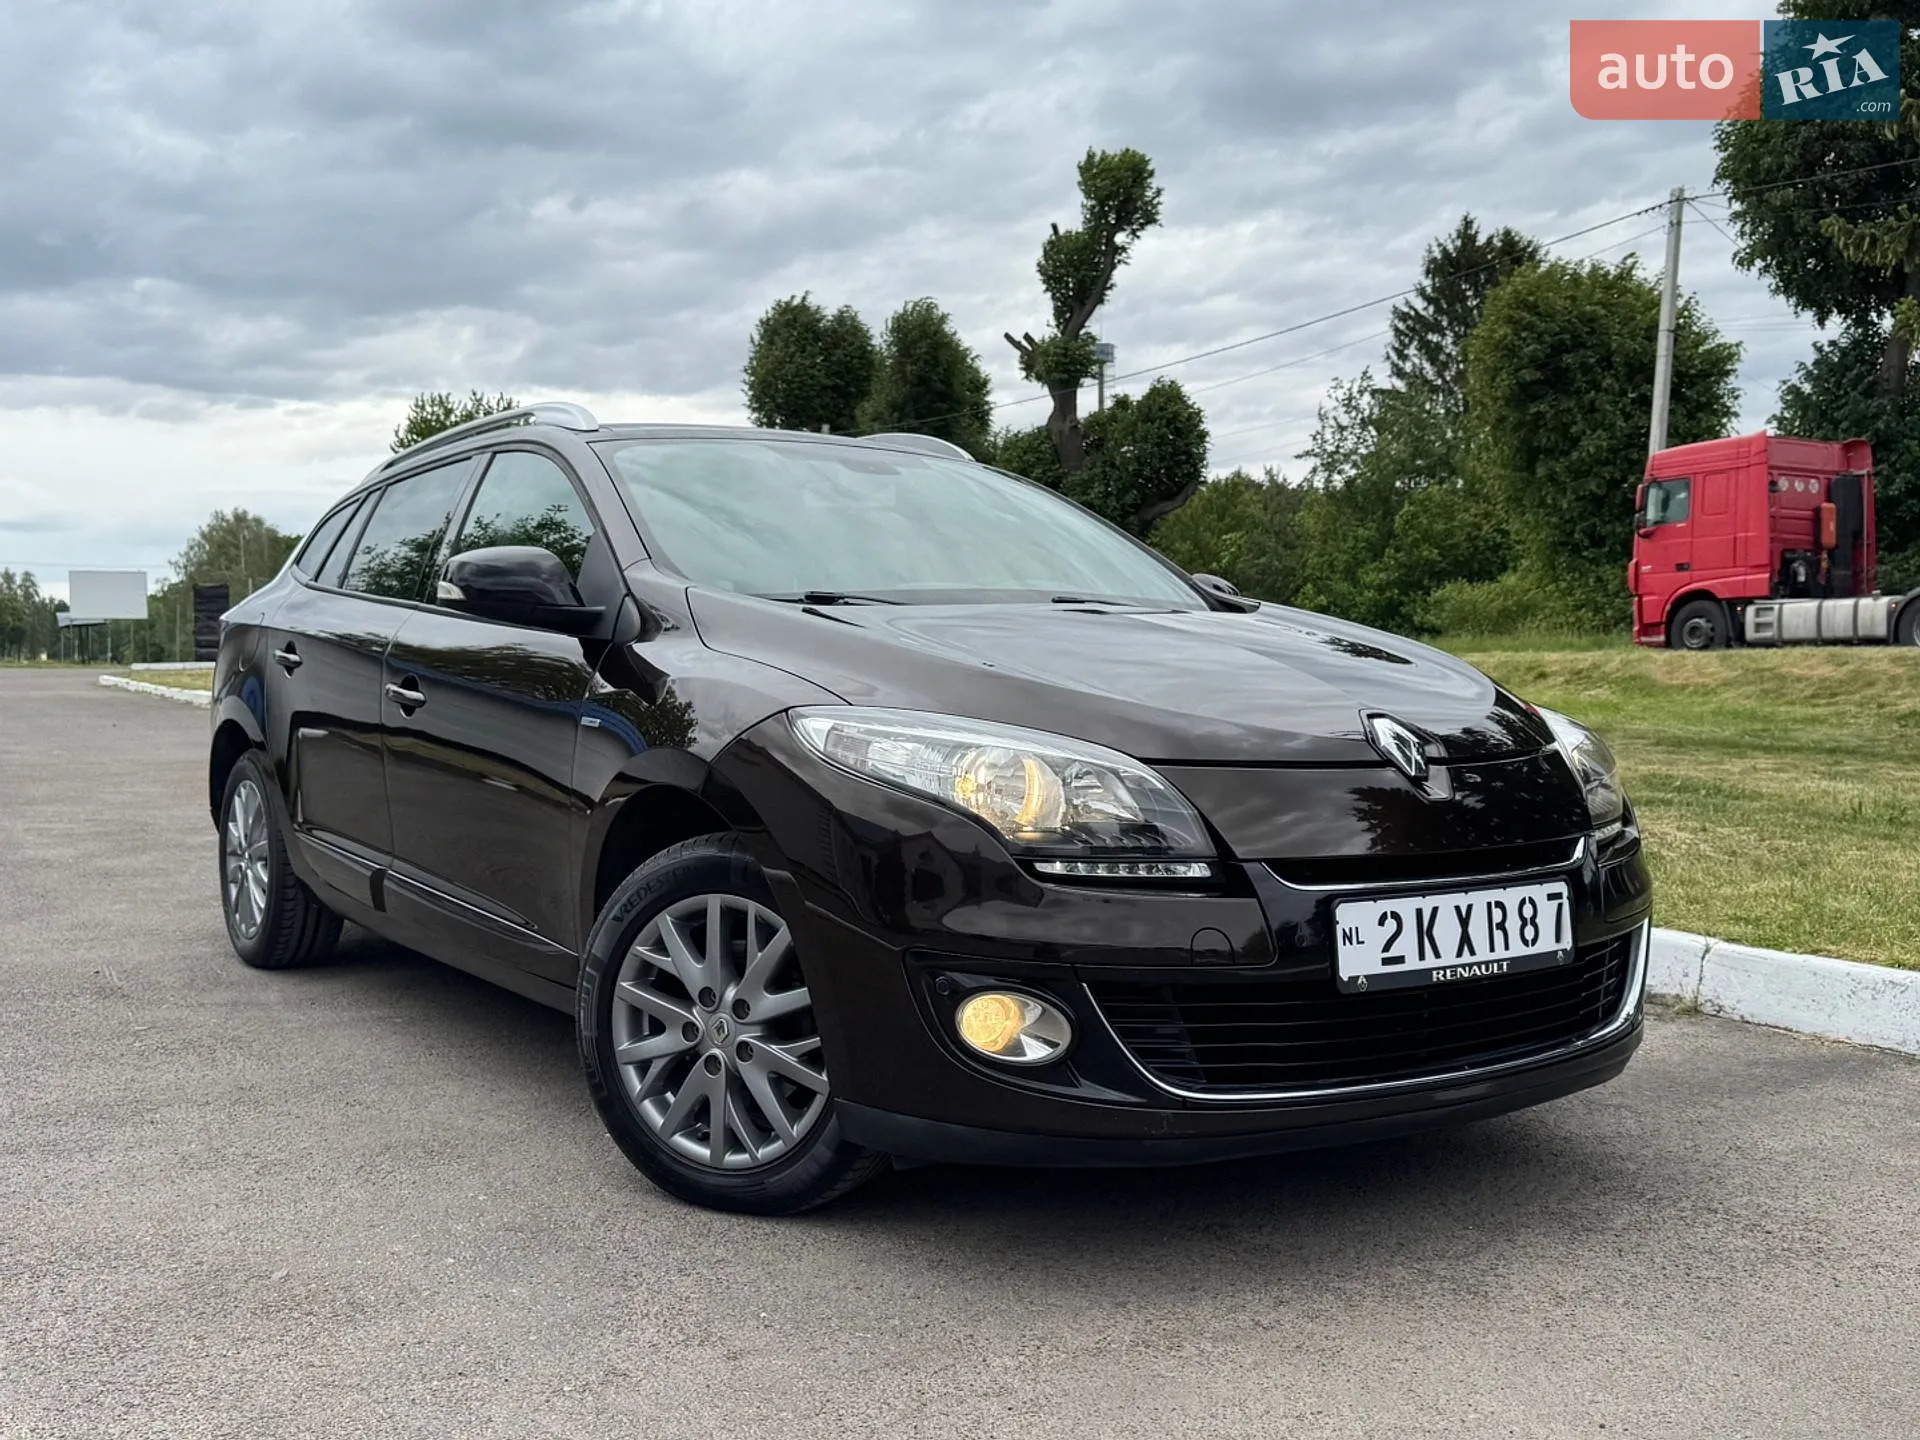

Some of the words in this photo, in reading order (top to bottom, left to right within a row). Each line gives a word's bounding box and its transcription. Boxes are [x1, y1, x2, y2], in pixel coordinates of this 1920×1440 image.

[1342, 926, 1365, 946] NL
[1377, 891, 1564, 967] 2KXR87
[1431, 960, 1511, 982] RENAULT
